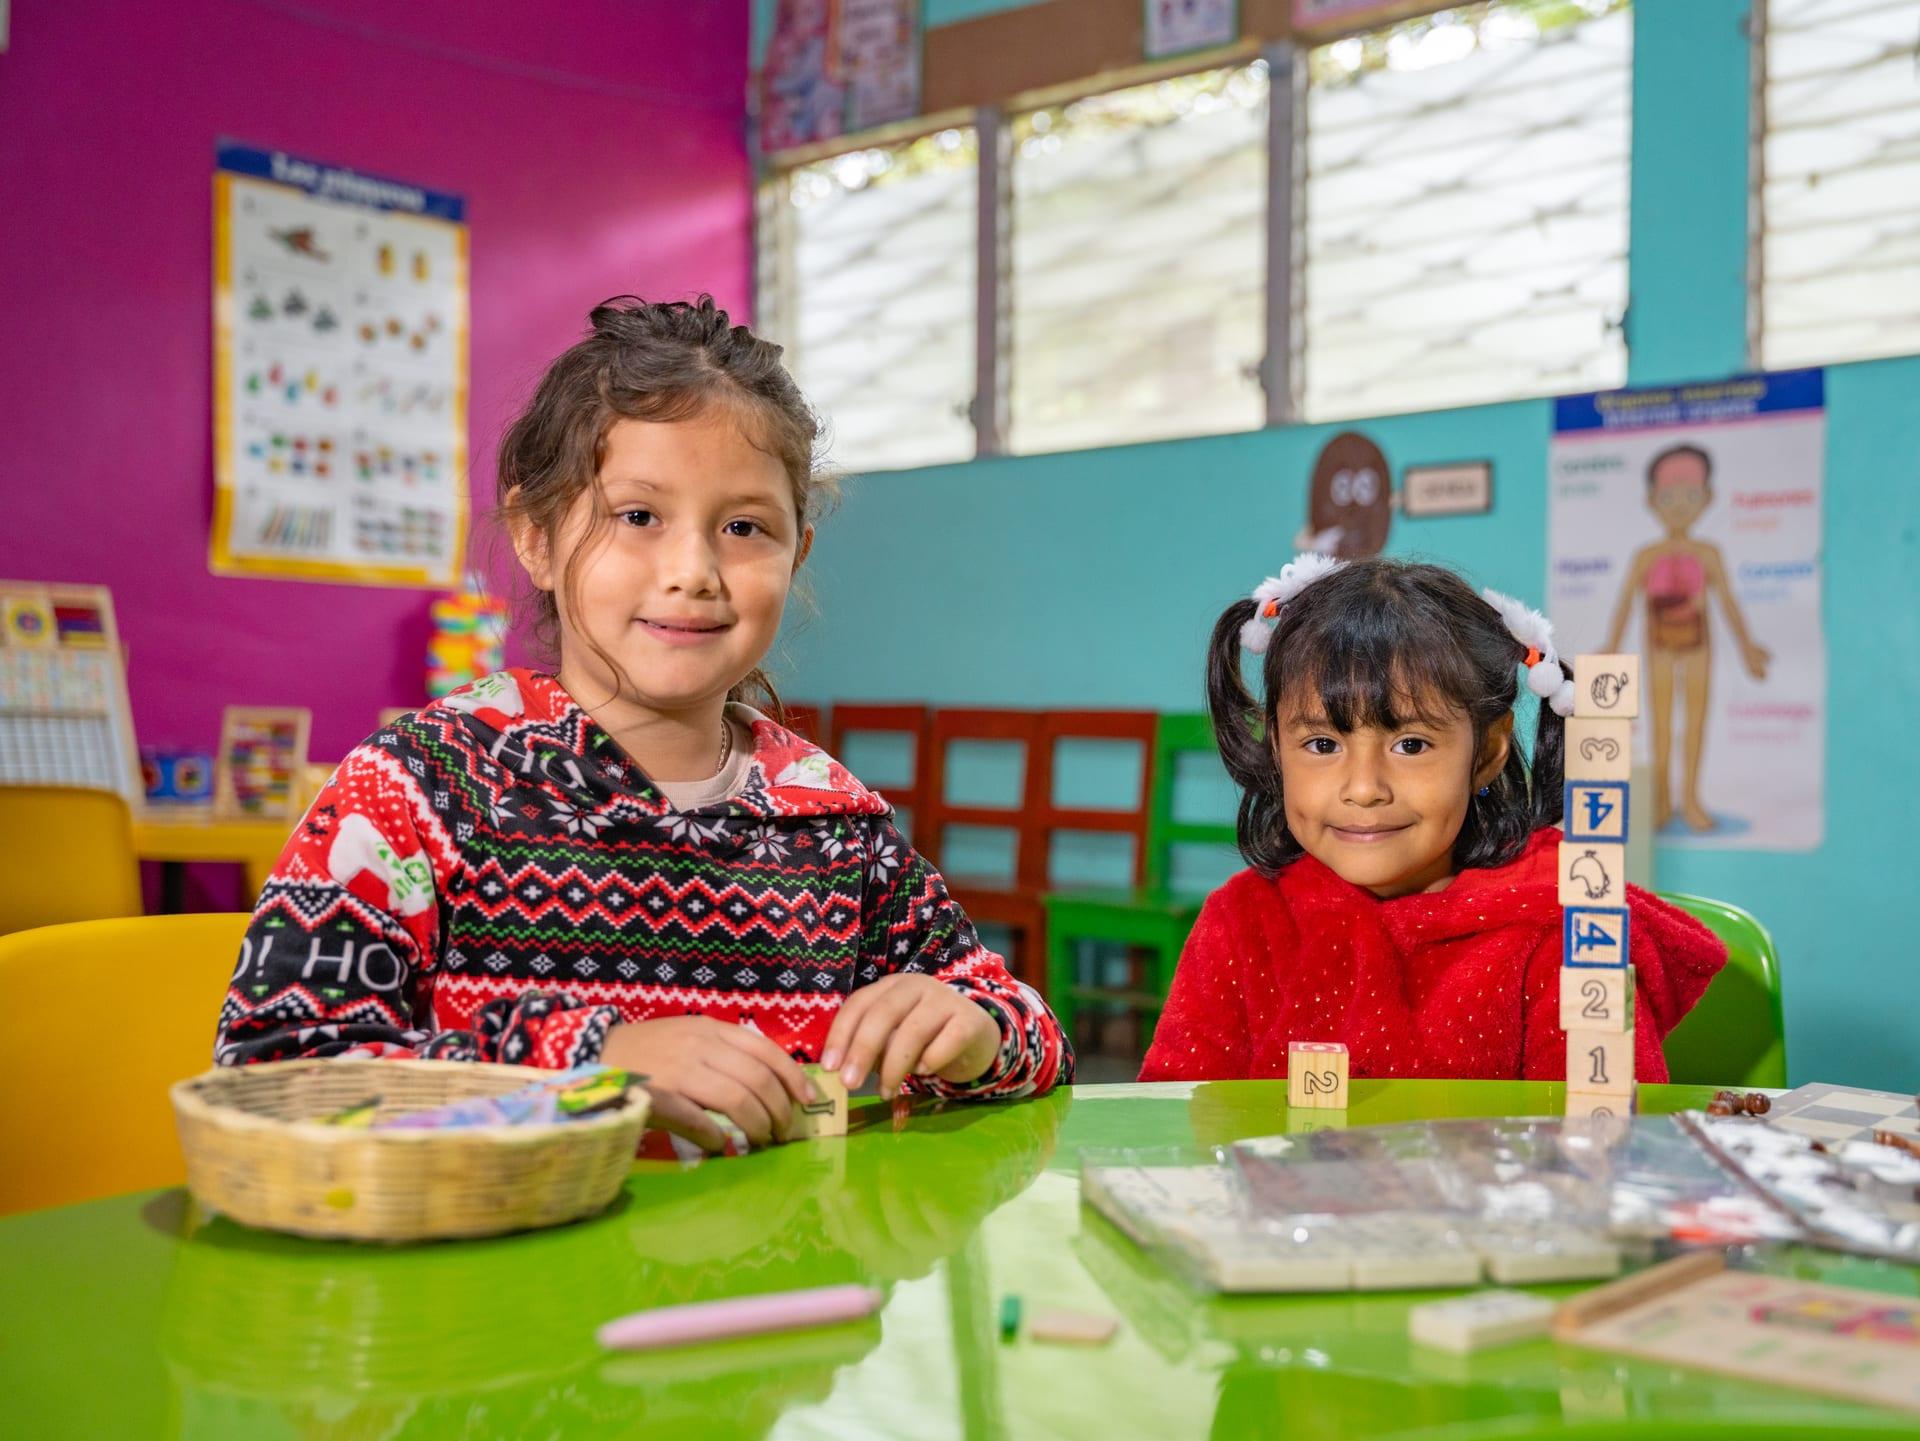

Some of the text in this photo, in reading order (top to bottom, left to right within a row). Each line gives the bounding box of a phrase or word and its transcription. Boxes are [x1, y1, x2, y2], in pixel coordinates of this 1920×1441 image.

[1580, 737, 1620, 762] 3
[1583, 791, 1614, 831] 4
[1574, 916, 1617, 956] 4
[301, 937, 402, 991] HO
[1581, 979, 1610, 1020] 2
[1304, 1070, 1339, 1095] 2
[1588, 1045, 1609, 1084] 1
